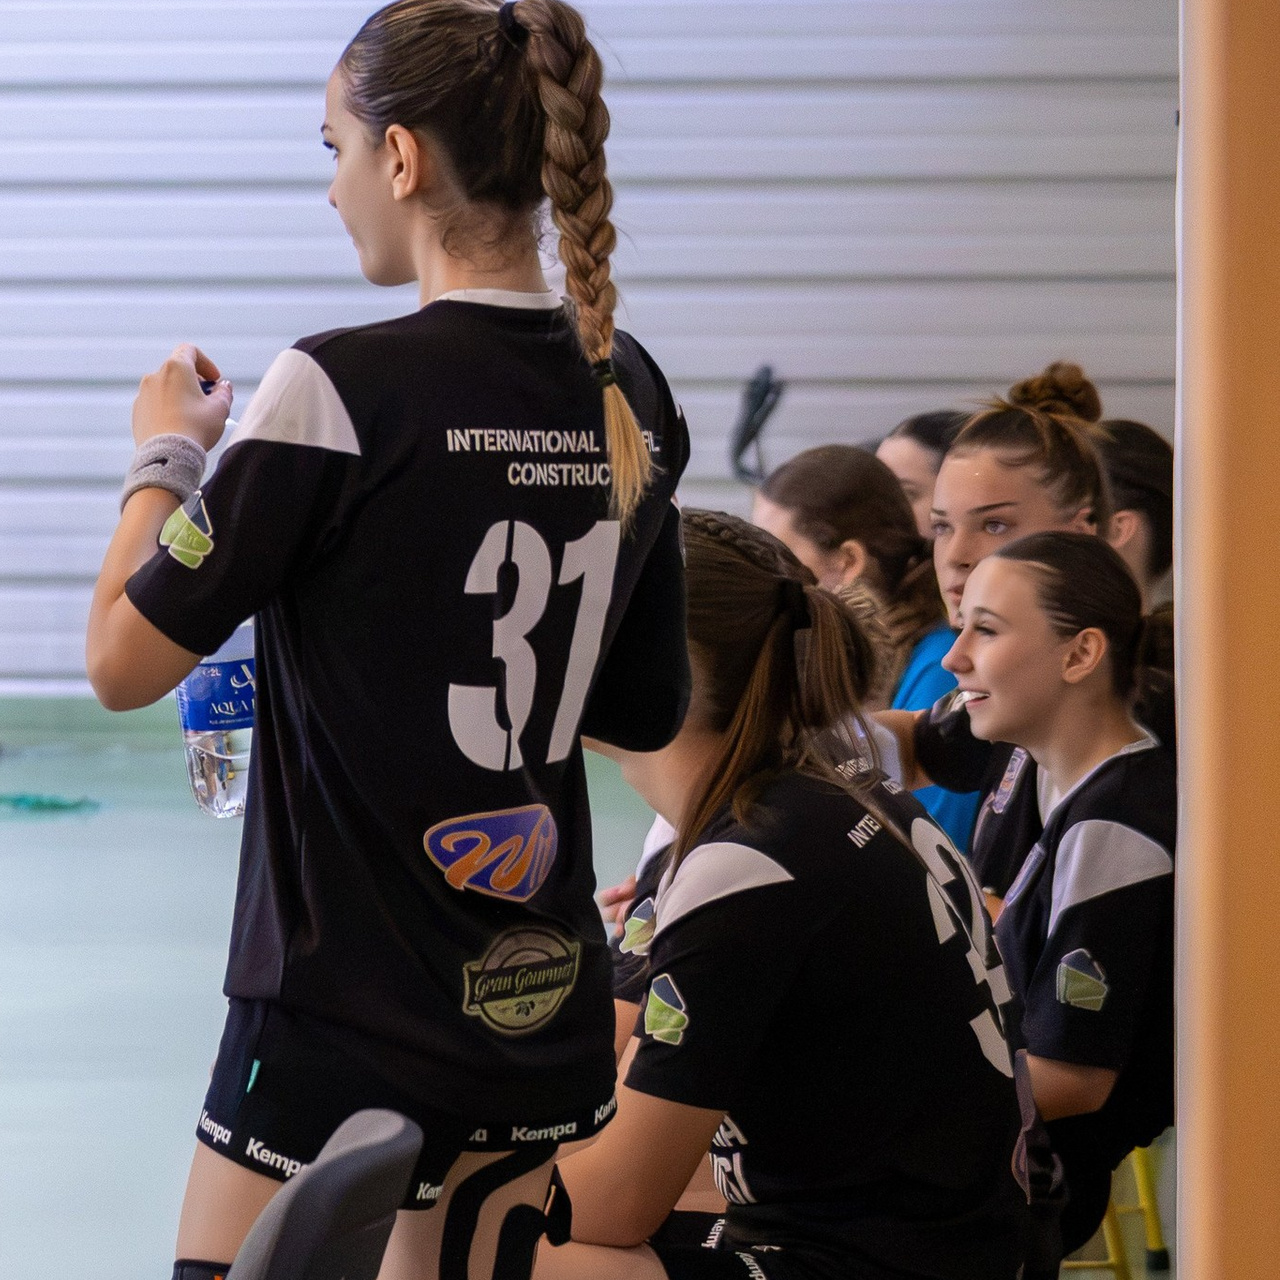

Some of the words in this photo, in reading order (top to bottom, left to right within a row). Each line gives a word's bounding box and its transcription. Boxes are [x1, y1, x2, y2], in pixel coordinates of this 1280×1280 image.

[446, 428, 601, 453] INTERNATIONAL
[507, 462, 611, 486] CONSTRUC
[447, 520, 620, 772] 31
[474, 972, 513, 1002] Gran
[200, 1109, 232, 1145] Kempa
[510, 1121, 578, 1142] Kempa
